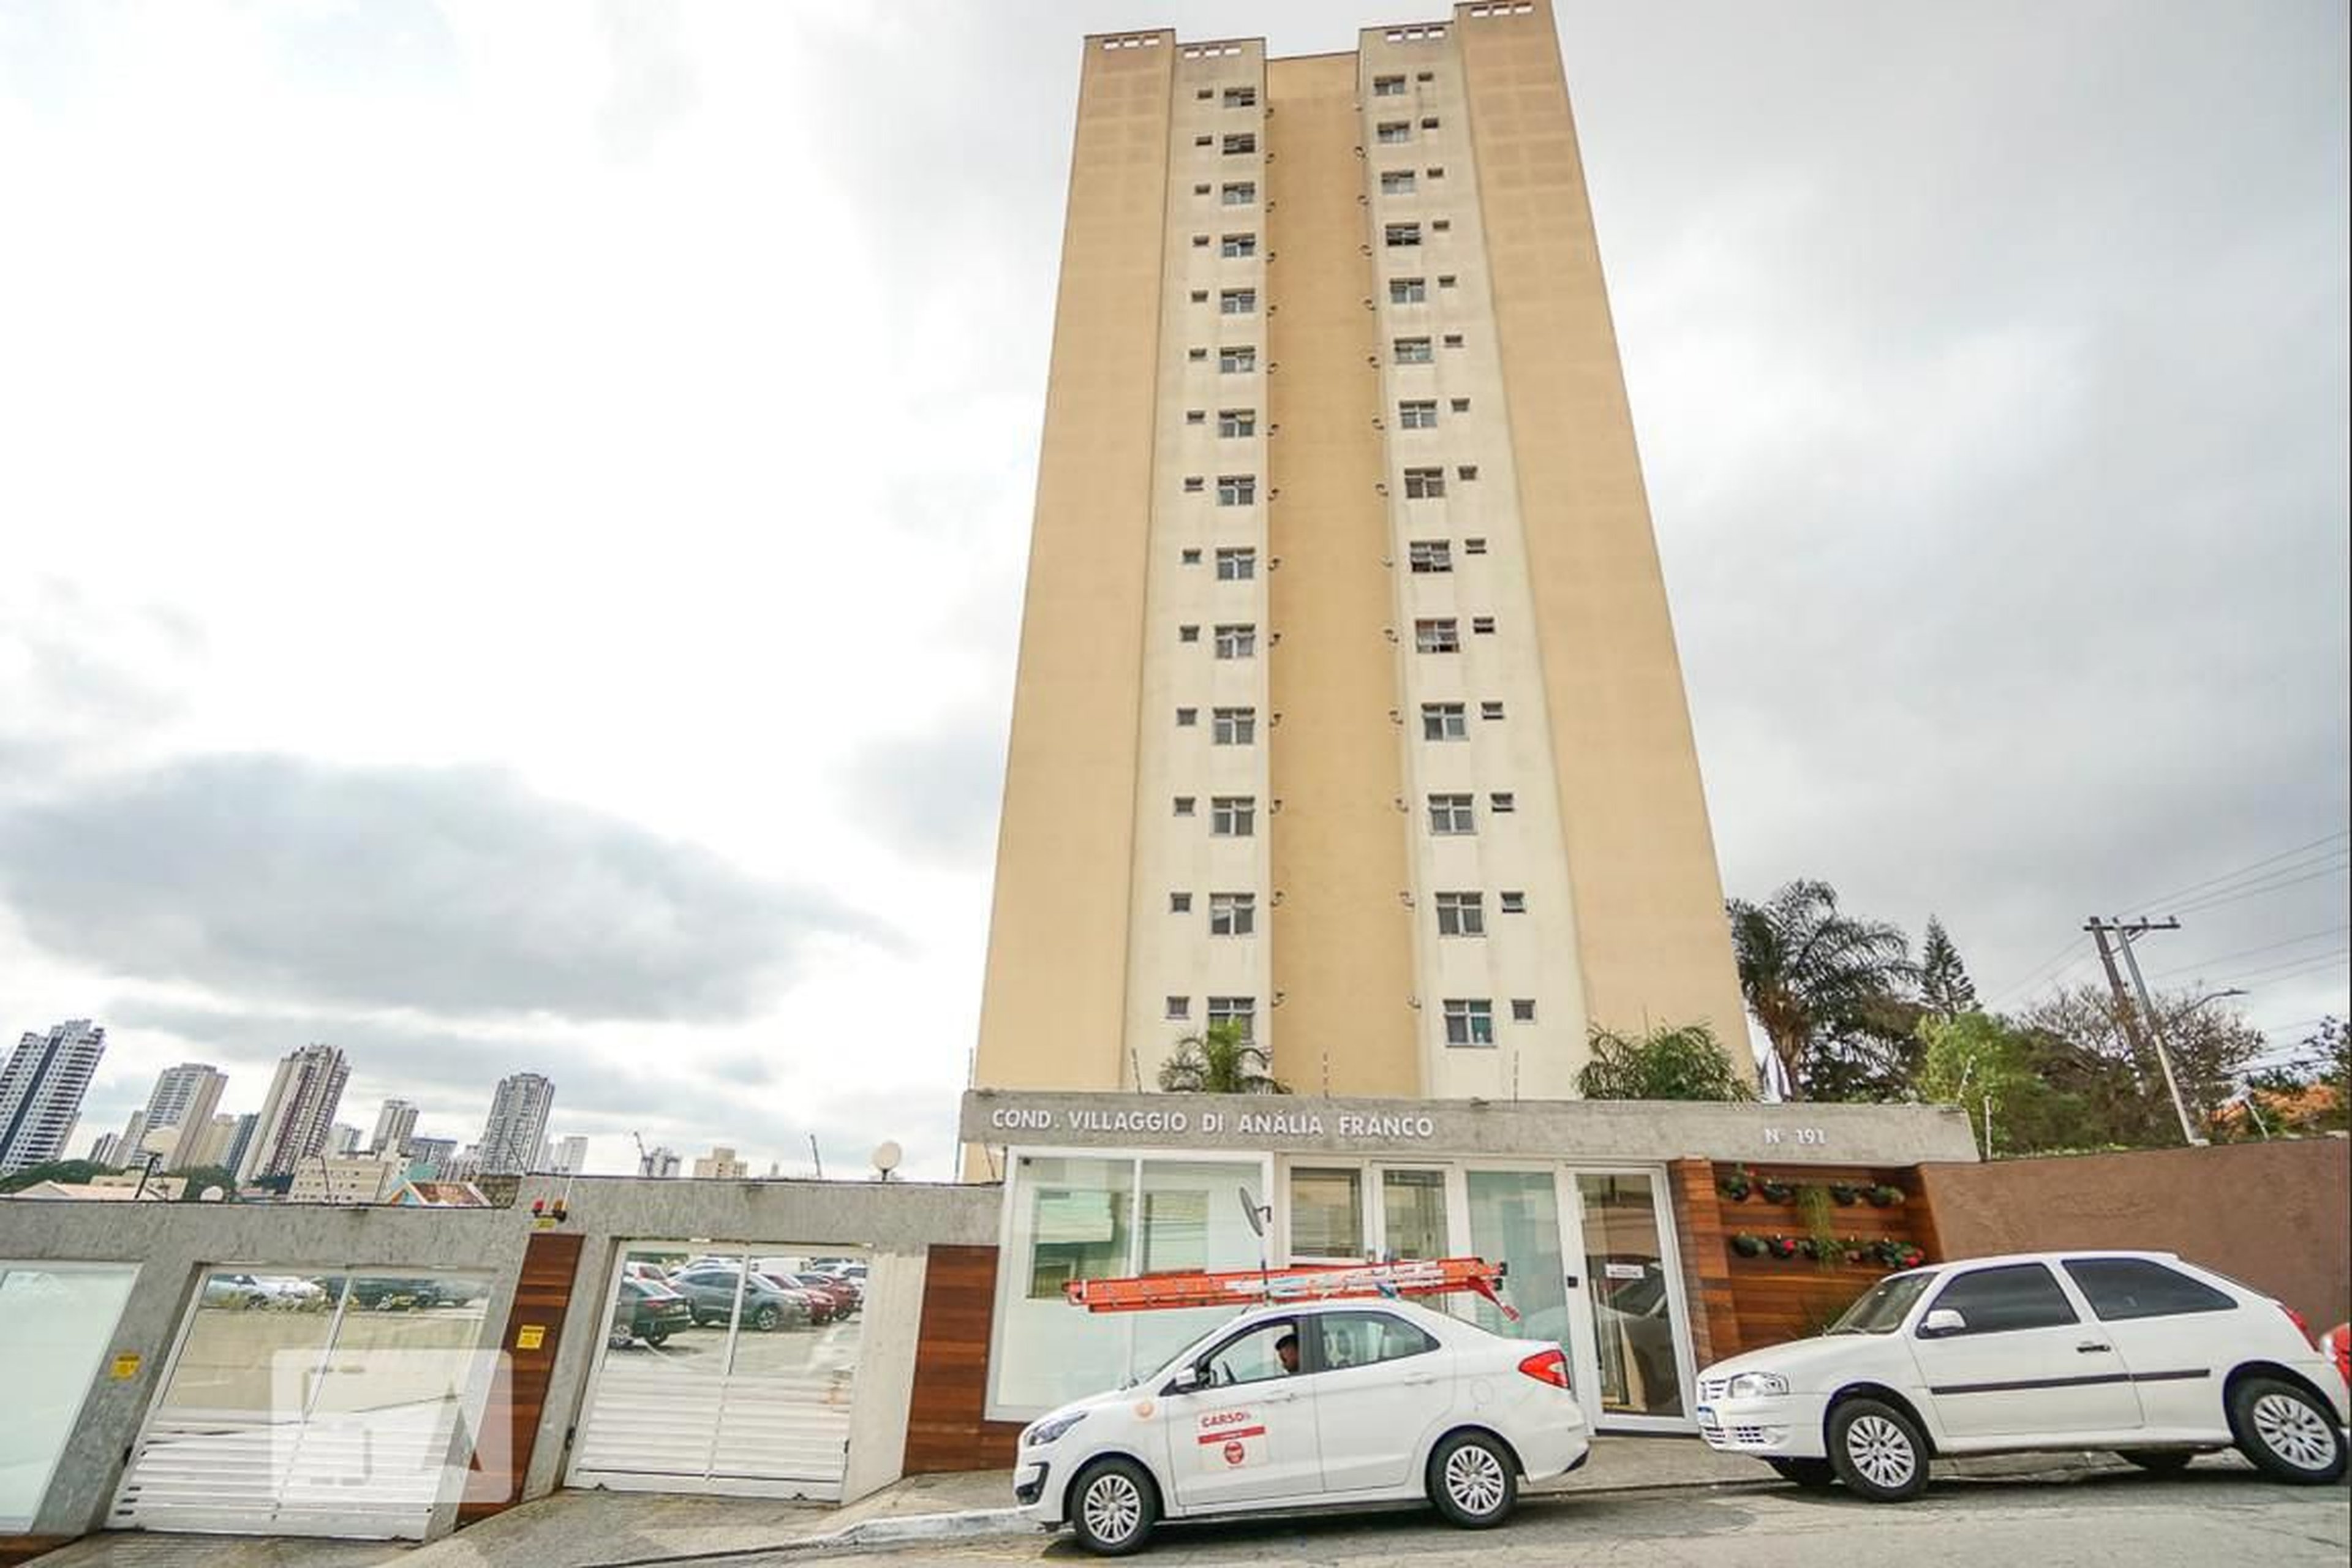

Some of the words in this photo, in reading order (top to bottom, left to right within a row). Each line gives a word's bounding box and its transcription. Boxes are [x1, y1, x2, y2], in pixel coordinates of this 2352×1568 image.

[992, 1109, 1061, 1128] COND.
[1069, 1110, 1188, 1131] VILLAGGIO
[1202, 1113, 1223, 1132] DI
[1339, 1116, 1434, 1137] FRANCO
